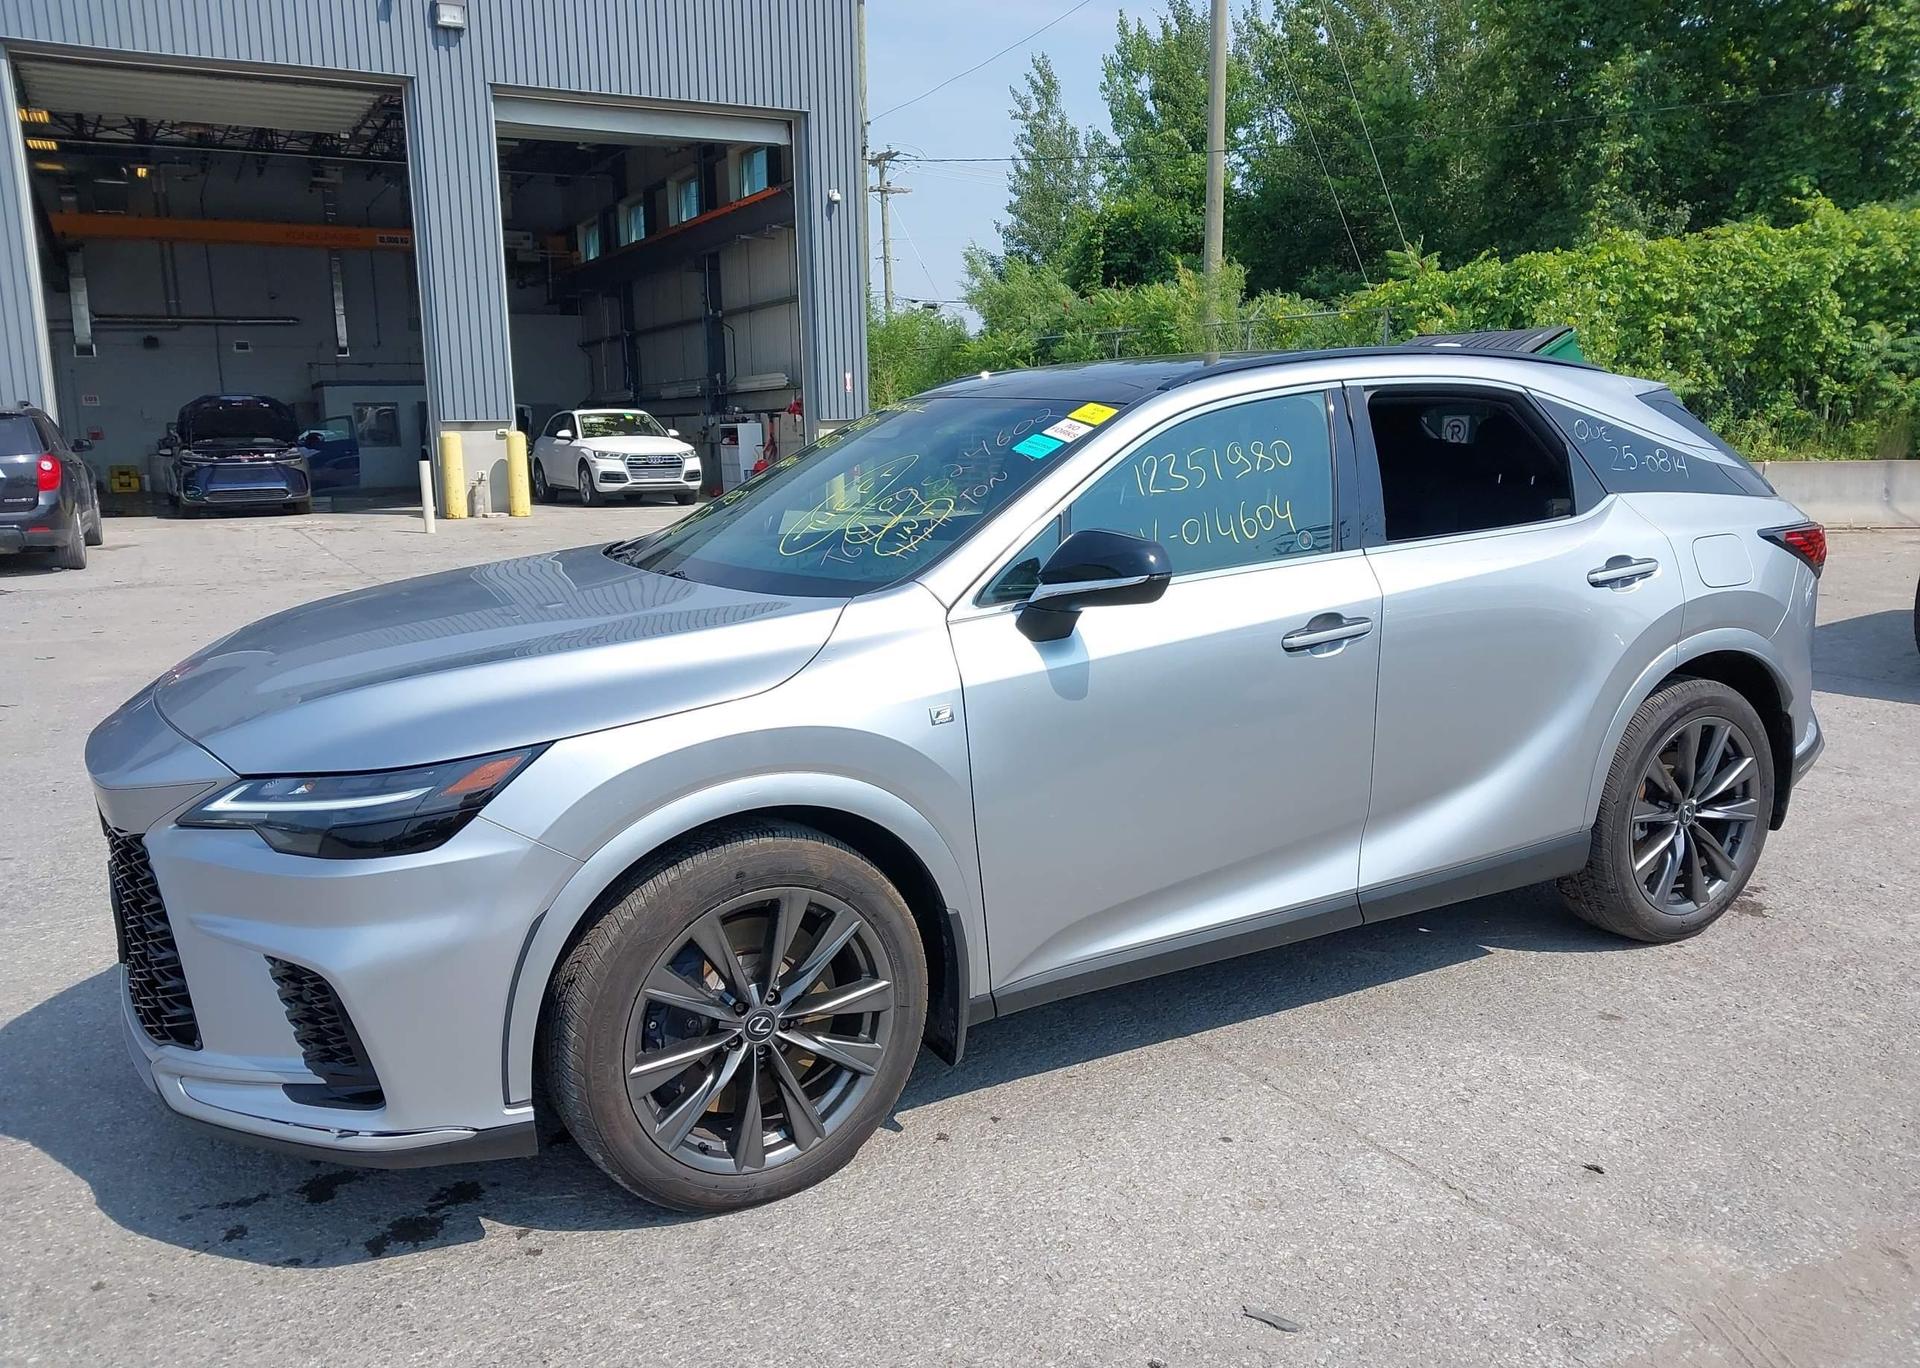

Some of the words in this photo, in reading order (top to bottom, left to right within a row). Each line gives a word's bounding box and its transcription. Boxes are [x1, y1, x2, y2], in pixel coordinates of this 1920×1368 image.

[1050, 426, 1079, 438] FORKS
[1066, 423, 1081, 431] NO
[1574, 419, 1612, 443] QUE
[1134, 440, 1293, 496] 12351980
[1608, 445, 1690, 479] 25-0814
